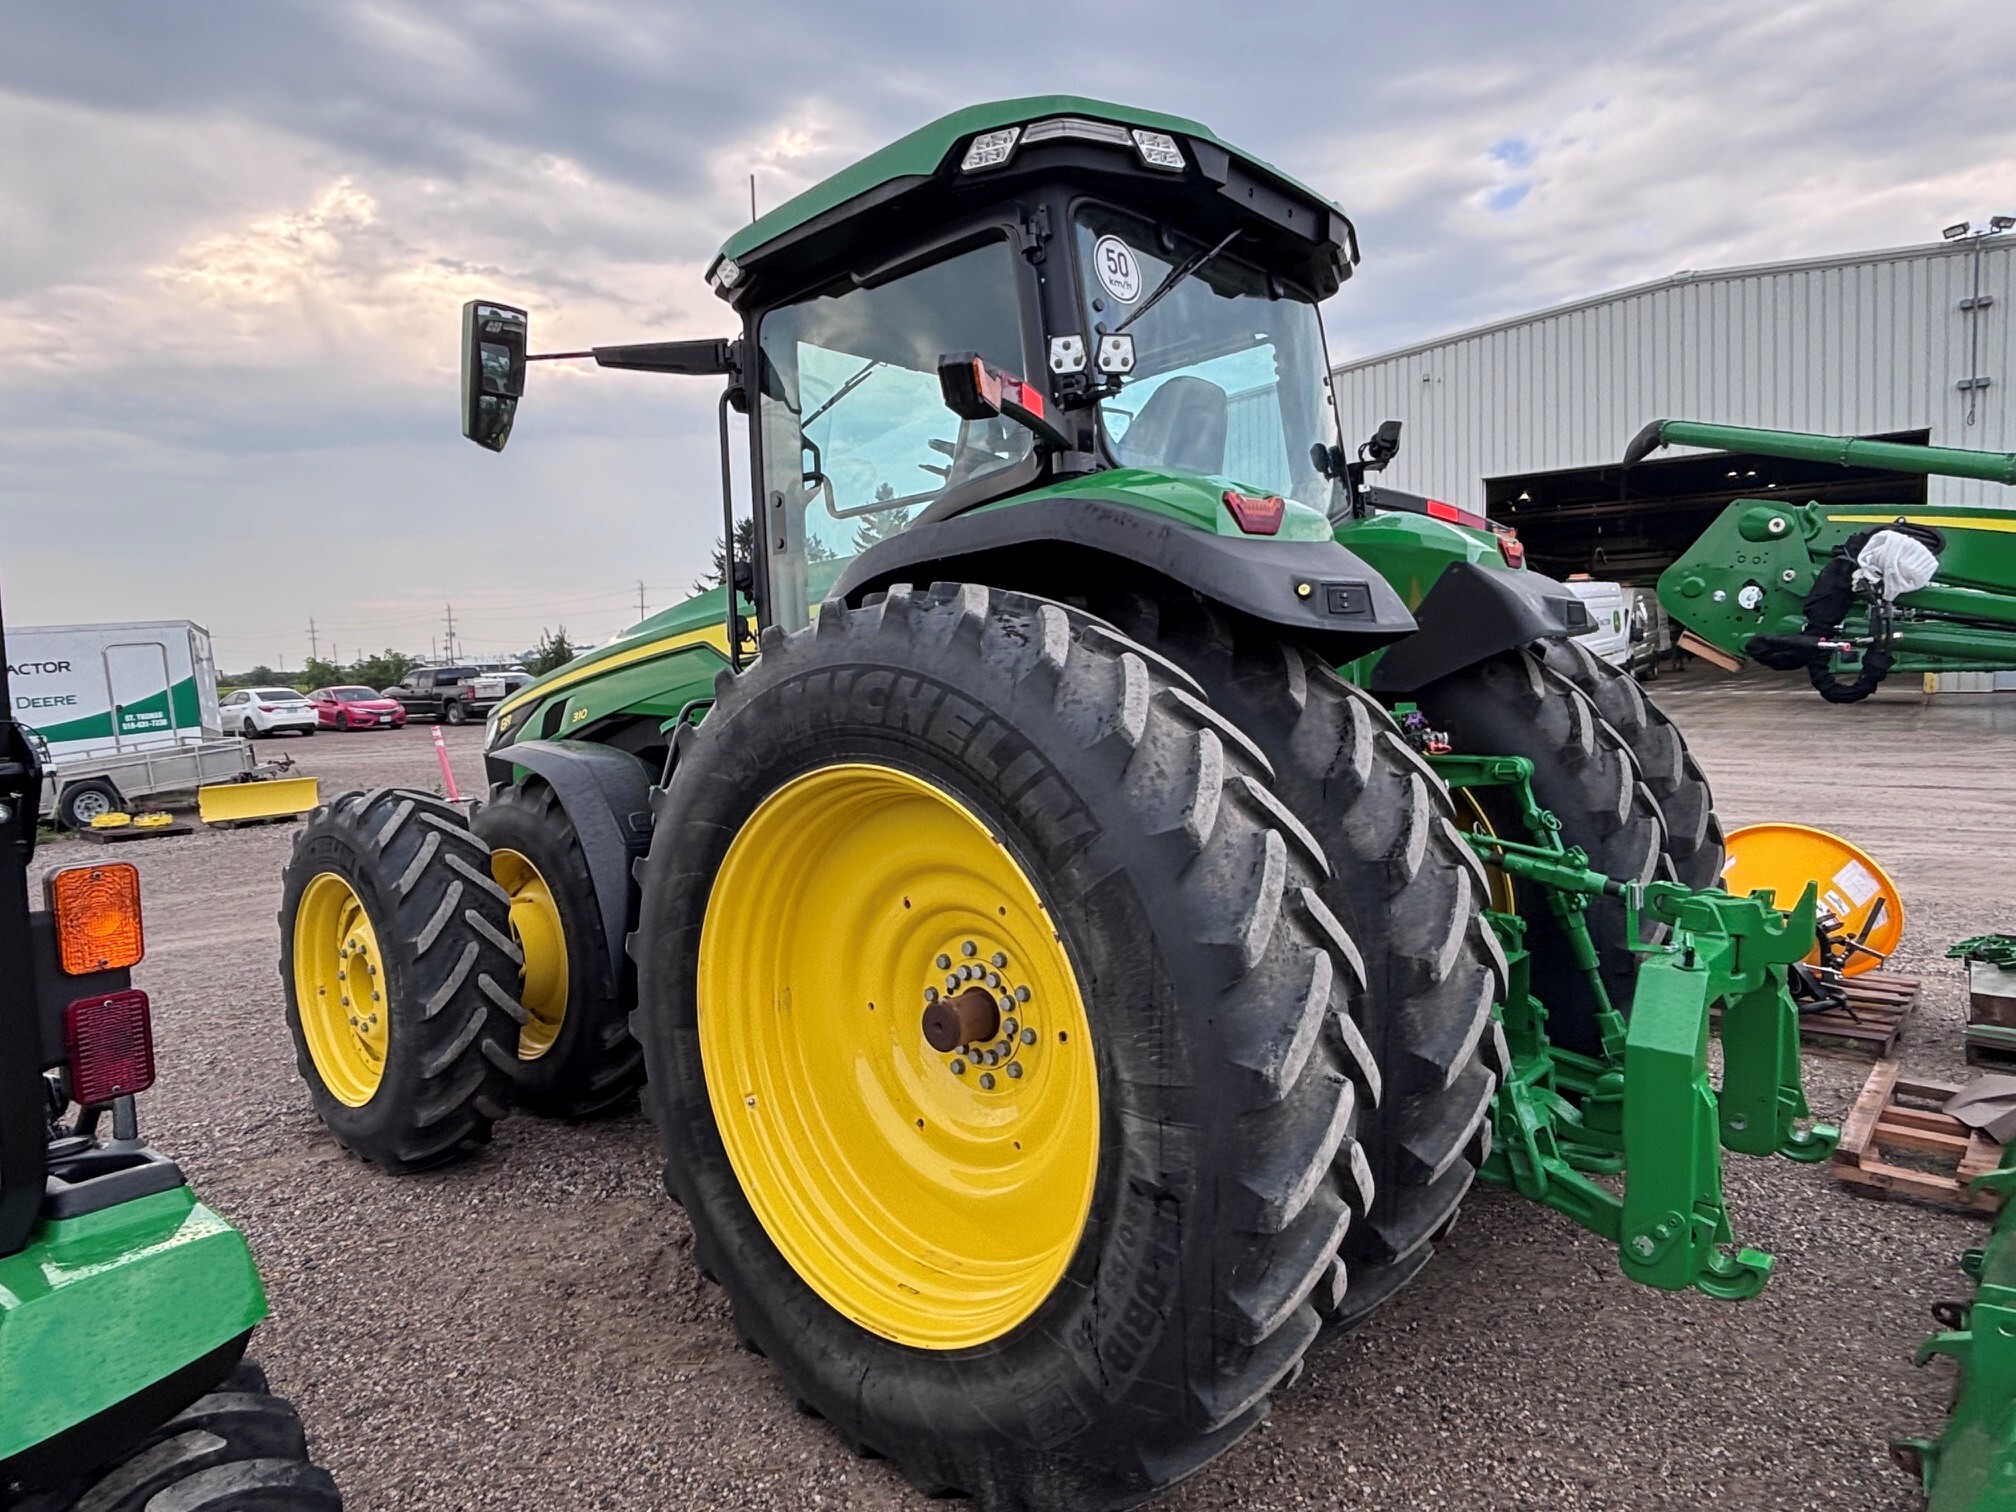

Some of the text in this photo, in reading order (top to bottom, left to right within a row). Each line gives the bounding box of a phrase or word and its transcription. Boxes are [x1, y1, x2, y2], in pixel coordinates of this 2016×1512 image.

[1106, 248, 1129, 277] 50
[1109, 276, 1132, 291] km/h
[16, 695, 77, 710] DEERE
[572, 708, 588, 722] 310
[776, 667, 1097, 850] MICHELIN
